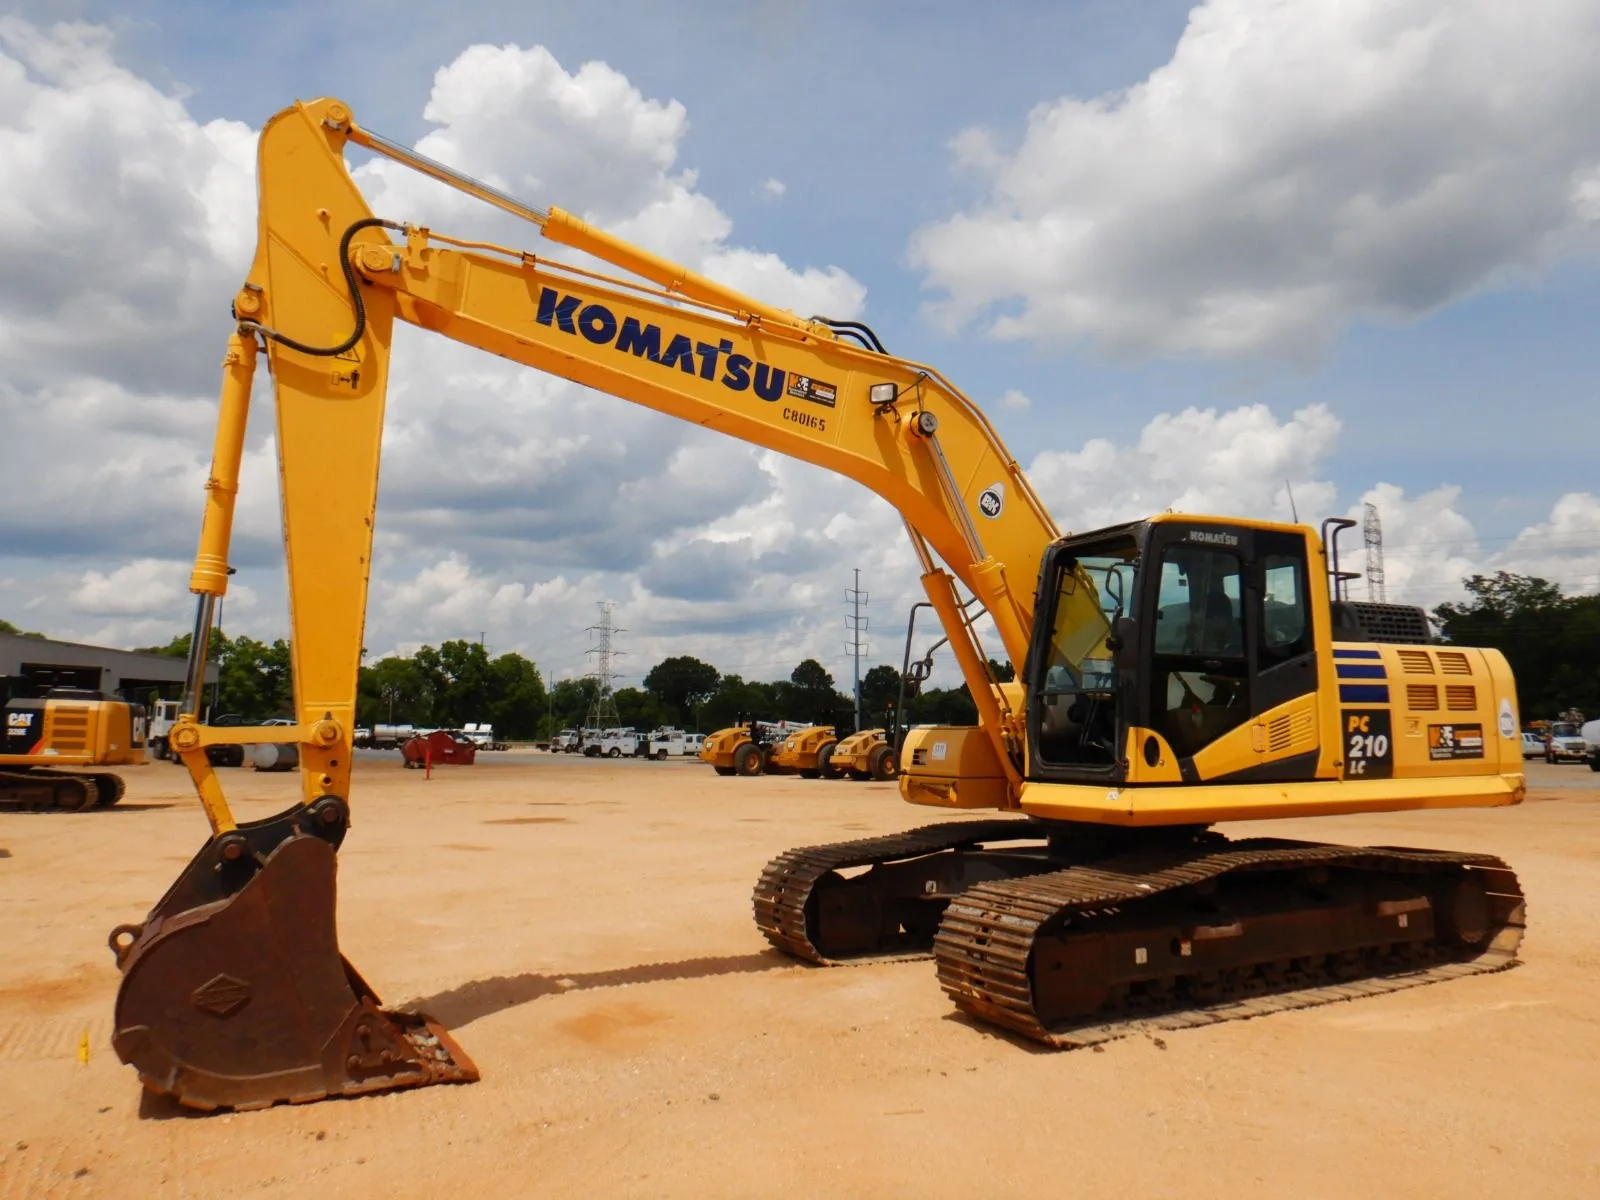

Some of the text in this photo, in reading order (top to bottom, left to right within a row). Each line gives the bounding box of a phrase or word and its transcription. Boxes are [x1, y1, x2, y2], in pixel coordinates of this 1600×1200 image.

[536, 287, 786, 402] KOMATSU
[783, 407, 826, 432] C80165
[1189, 530, 1238, 546] KOMATSU
[8, 713, 34, 727] CAT
[1348, 715, 1370, 733] PC
[1349, 734, 1388, 758] 210
[1350, 760, 1366, 775] LC
